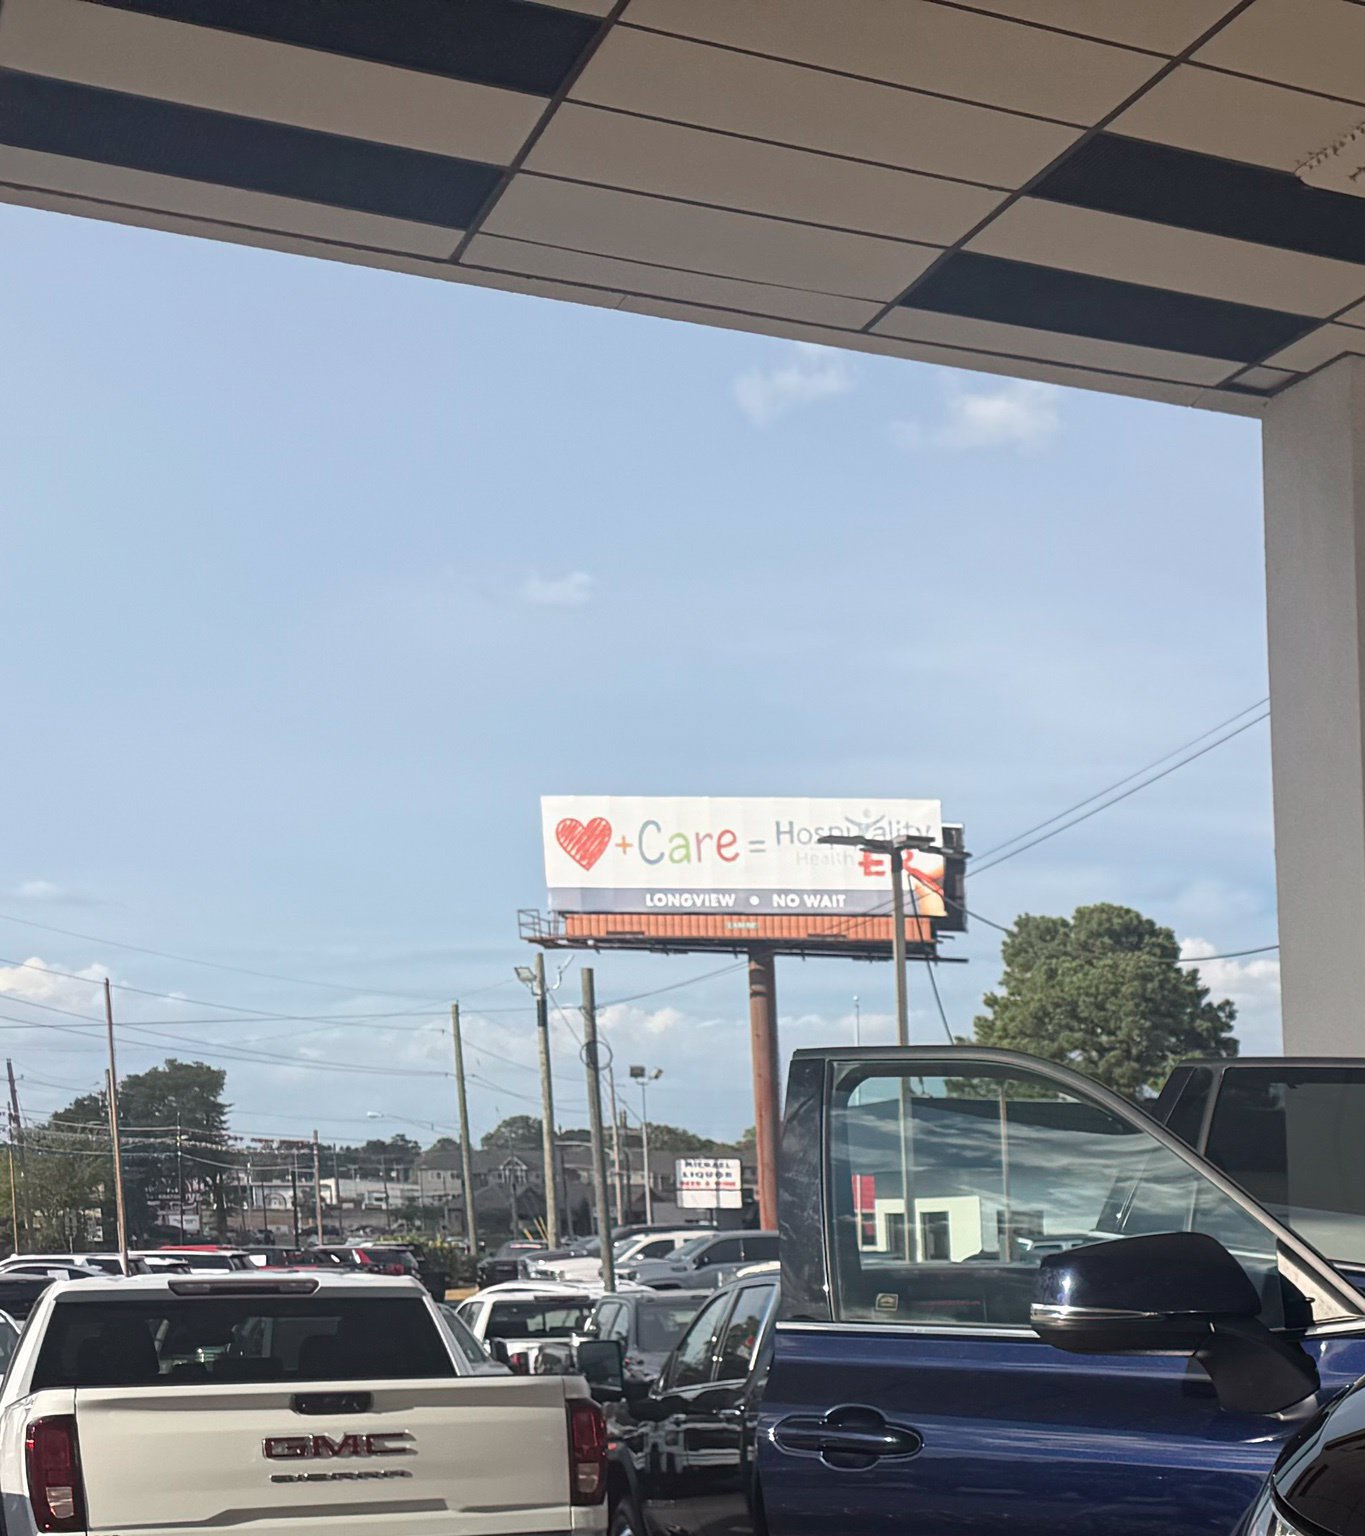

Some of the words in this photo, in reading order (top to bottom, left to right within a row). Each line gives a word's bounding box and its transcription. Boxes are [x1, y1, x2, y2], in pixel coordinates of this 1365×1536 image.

[638, 819, 740, 865] Care
[796, 850, 855, 867] Health
[645, 892, 736, 908] LONGVIEW
[771, 893, 799, 908] NO
[802, 893, 847, 909] WAIT
[682, 1171, 733, 1179] LIQUOR
[262, 1430, 419, 1461] GMC
